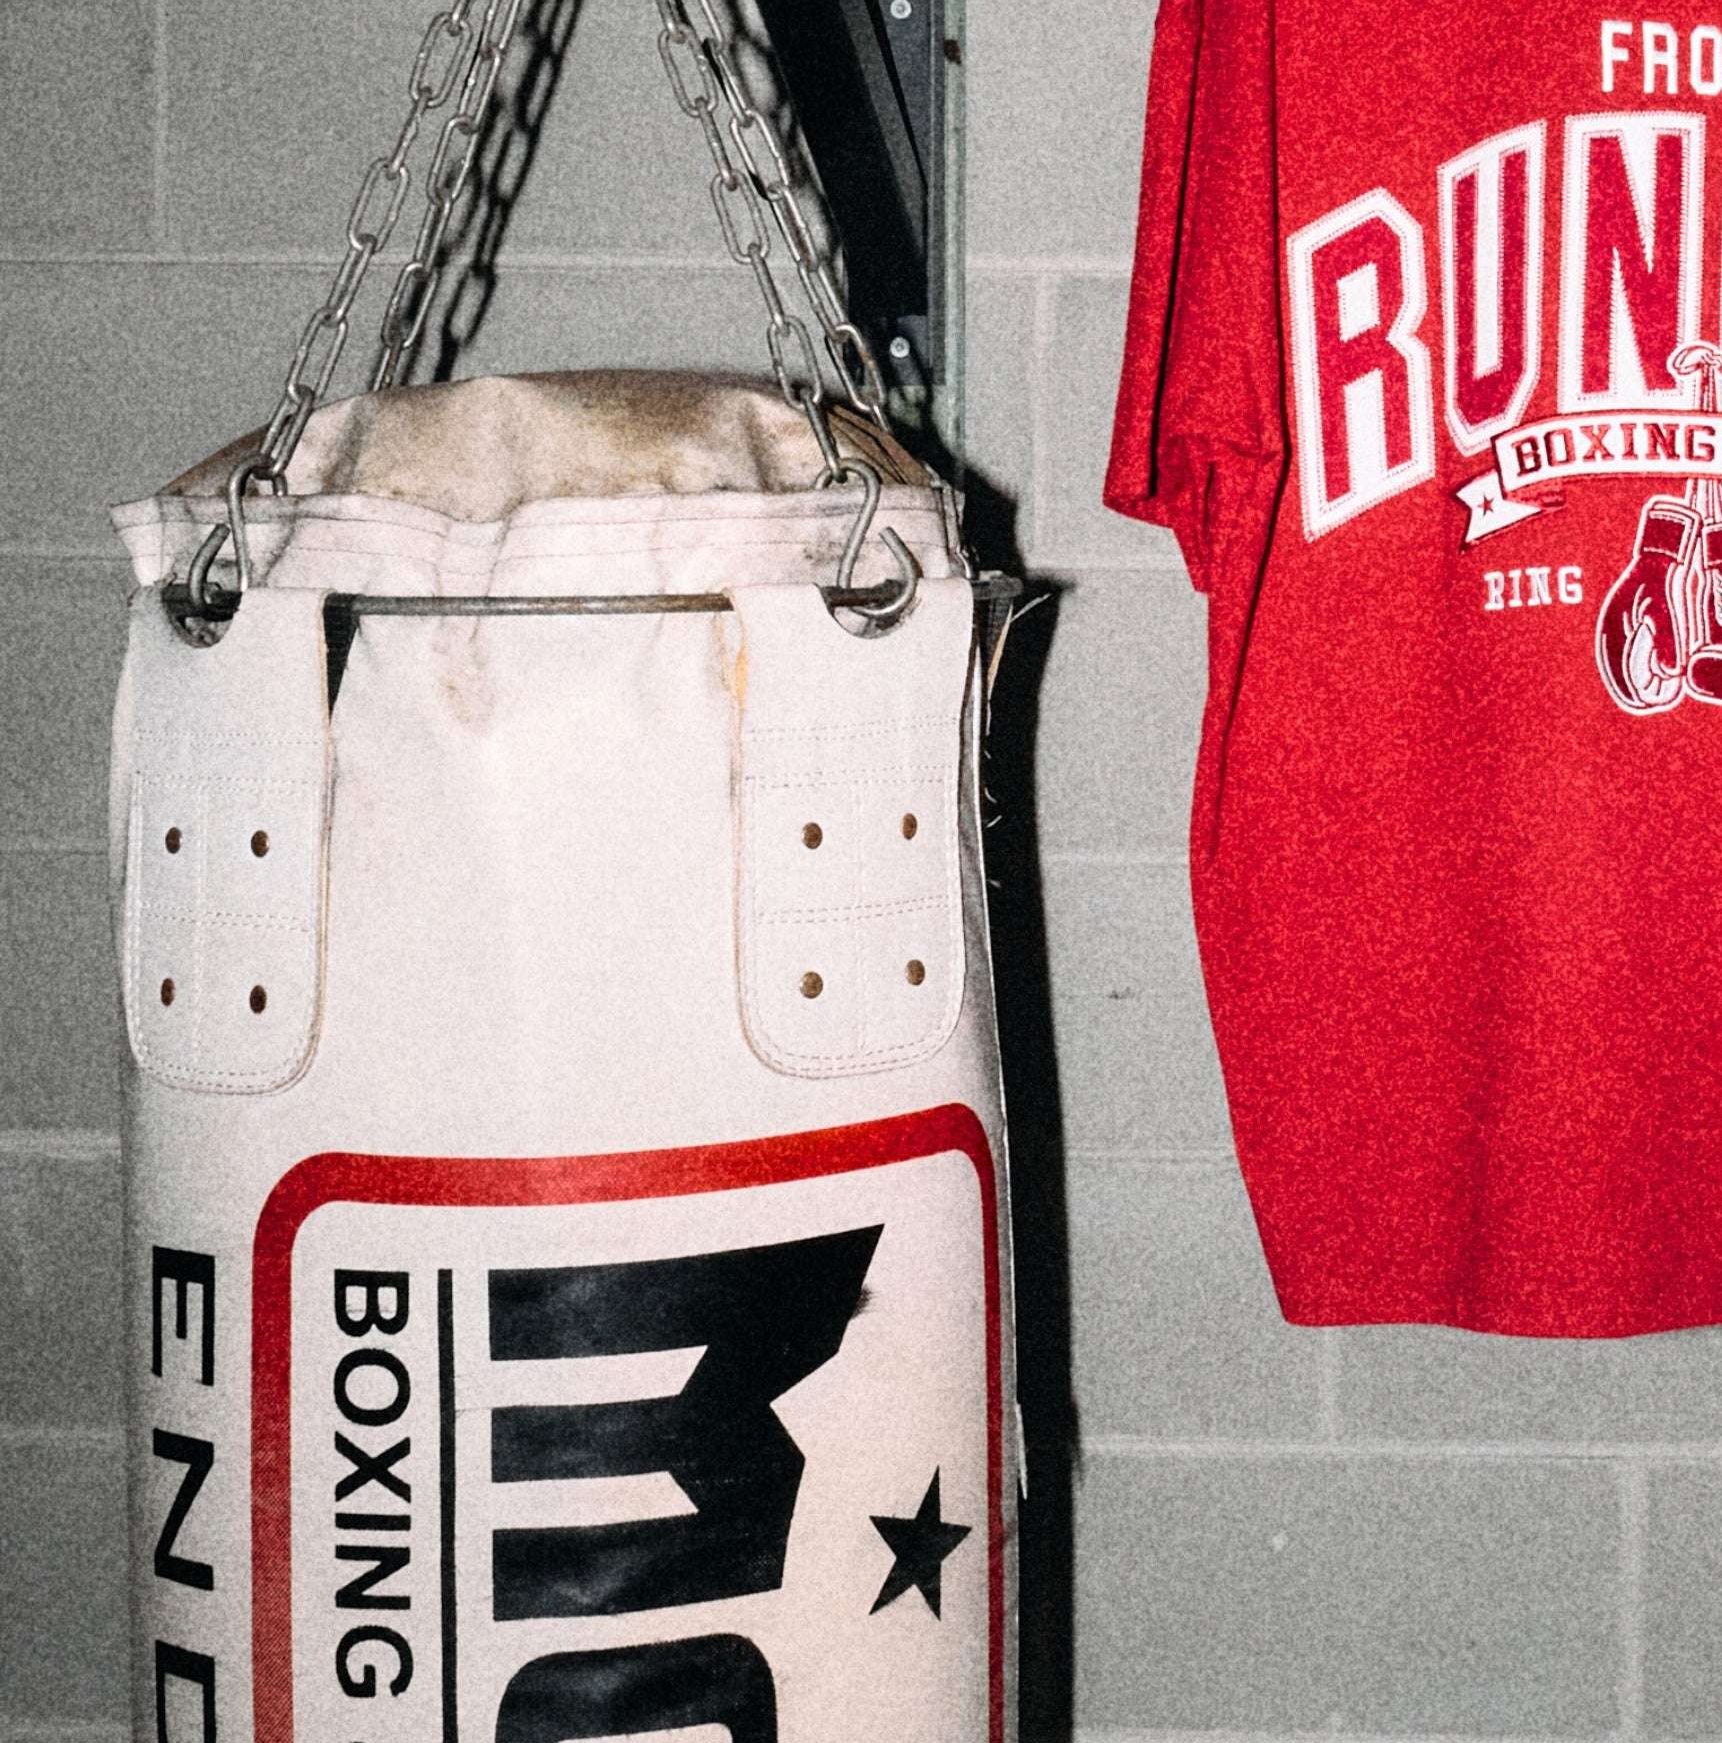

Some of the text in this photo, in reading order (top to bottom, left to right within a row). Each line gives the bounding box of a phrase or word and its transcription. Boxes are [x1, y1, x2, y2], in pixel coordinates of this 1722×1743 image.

[1511, 423, 1718, 477] BOXING
[1483, 565, 1584, 611] RING
[333, 1268, 414, 1699] BOXING
